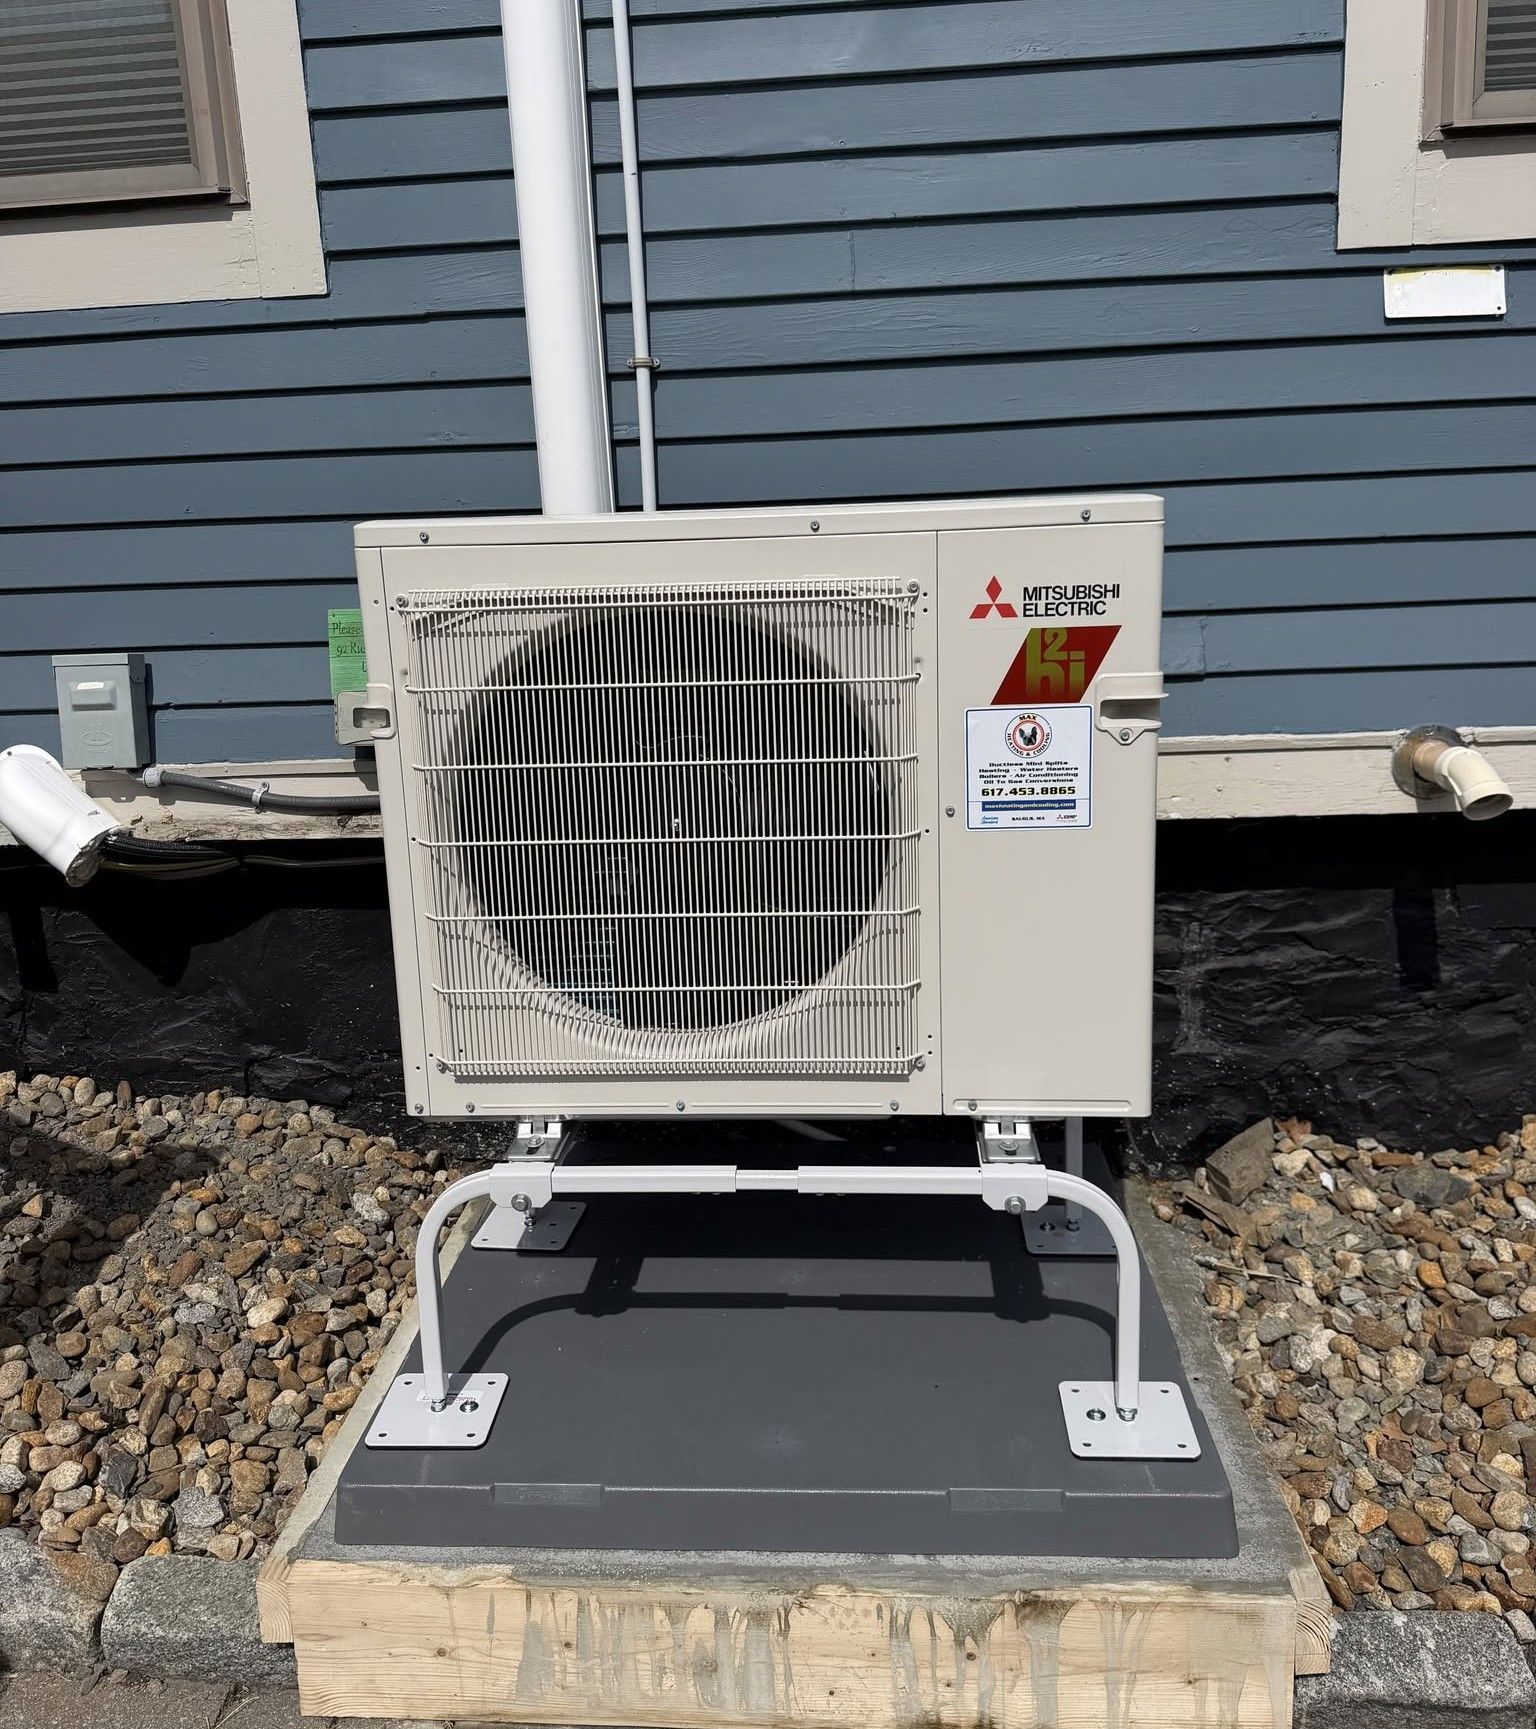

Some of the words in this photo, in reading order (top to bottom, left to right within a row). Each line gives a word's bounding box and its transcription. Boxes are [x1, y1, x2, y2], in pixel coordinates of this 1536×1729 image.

[1023, 584, 1120, 601] MITSUBISHI
[1023, 601, 1106, 617] ELECTRIC
[332, 621, 361, 635] Please
[336, 645, 348, 658] 92
[981, 786, 1076, 797] 617.453.8865
